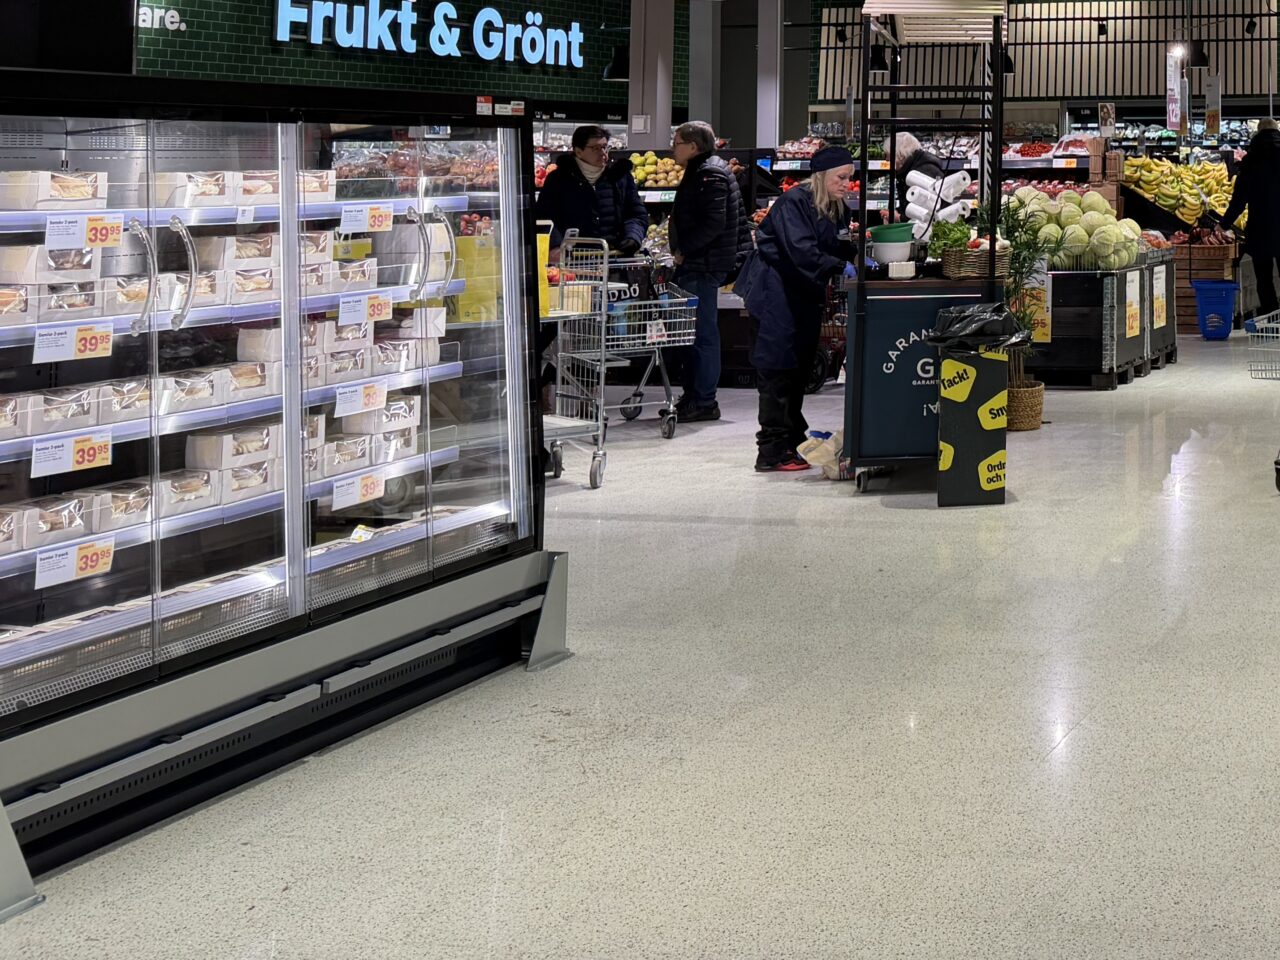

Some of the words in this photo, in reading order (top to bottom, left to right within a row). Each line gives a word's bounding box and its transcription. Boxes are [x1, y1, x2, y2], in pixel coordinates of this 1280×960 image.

[428, 0, 462, 58] &
[472, 9, 585, 69] Grönt
[916, 357, 935, 378] G
[941, 368, 970, 391] Tack!
[986, 473, 1002, 484] och
